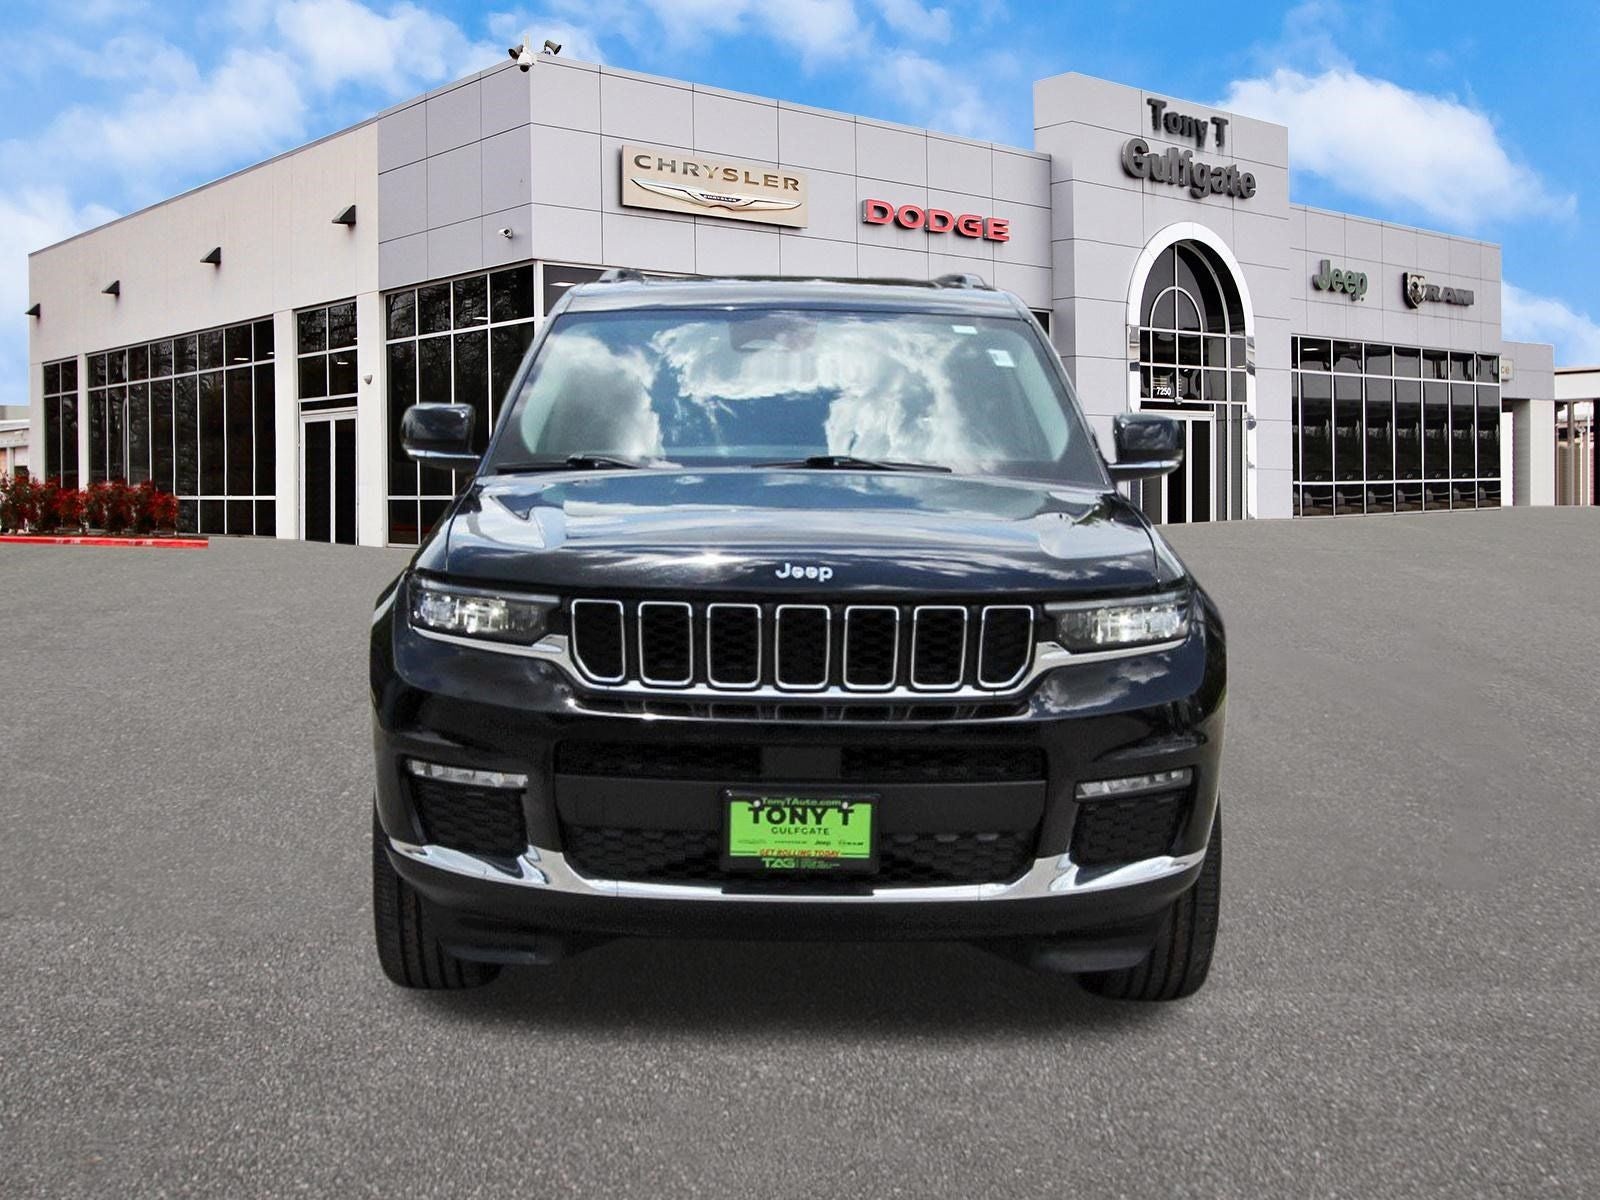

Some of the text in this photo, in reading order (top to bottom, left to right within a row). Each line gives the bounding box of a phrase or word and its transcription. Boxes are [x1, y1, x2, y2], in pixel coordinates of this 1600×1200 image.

[1147, 98, 1229, 148] Tony T
[633, 153, 800, 192] CHRYSLER
[1121, 137, 1257, 200] Gulfgate
[863, 198, 1010, 243] DODGE
[1312, 259, 1368, 302] Jeep
[1424, 283, 1475, 307] RAM
[1155, 386, 1172, 396] 7250
[775, 562, 834, 582] Jeep
[747, 805, 855, 826] TONY T
[771, 826, 830, 836] GULFGATE
